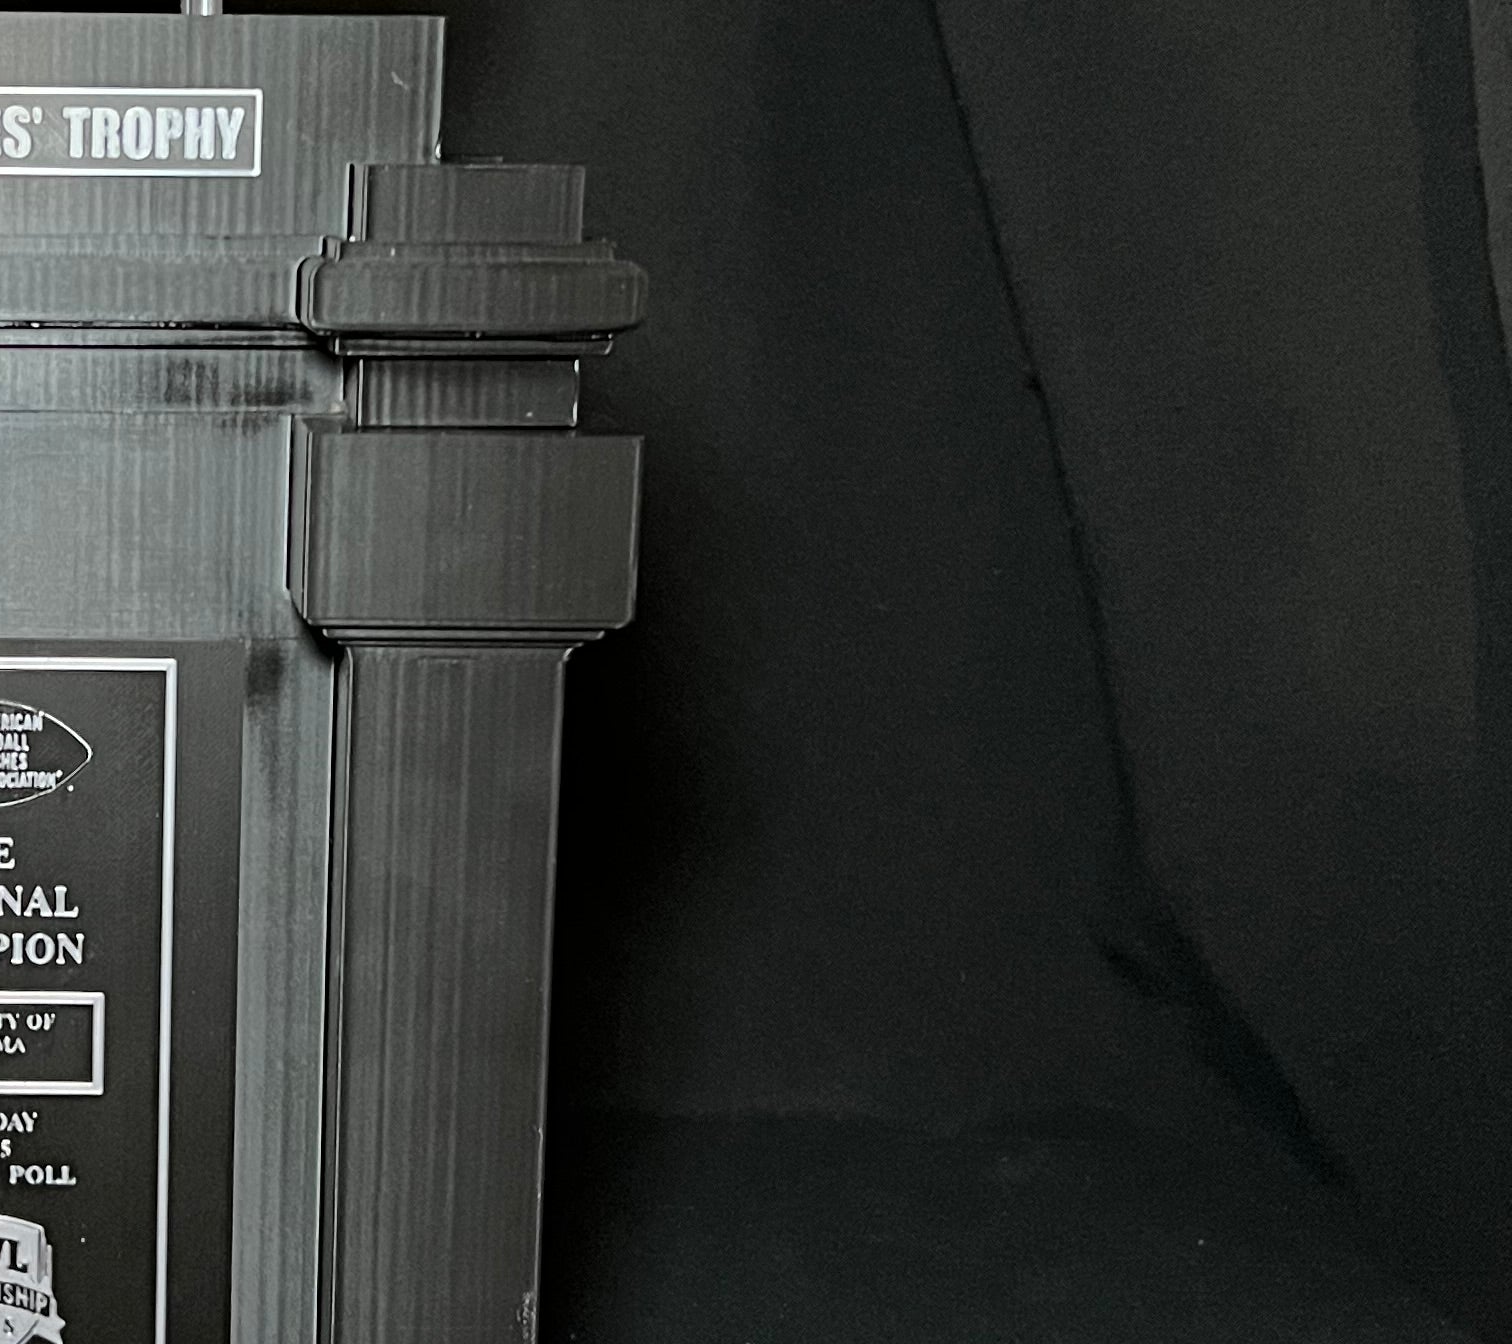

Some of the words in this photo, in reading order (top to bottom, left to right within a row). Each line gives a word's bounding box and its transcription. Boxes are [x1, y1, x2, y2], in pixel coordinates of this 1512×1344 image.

[62, 107, 245, 160] TROPHY
[26, 1013, 56, 1031] OF
[8, 1164, 77, 1185] POLL
